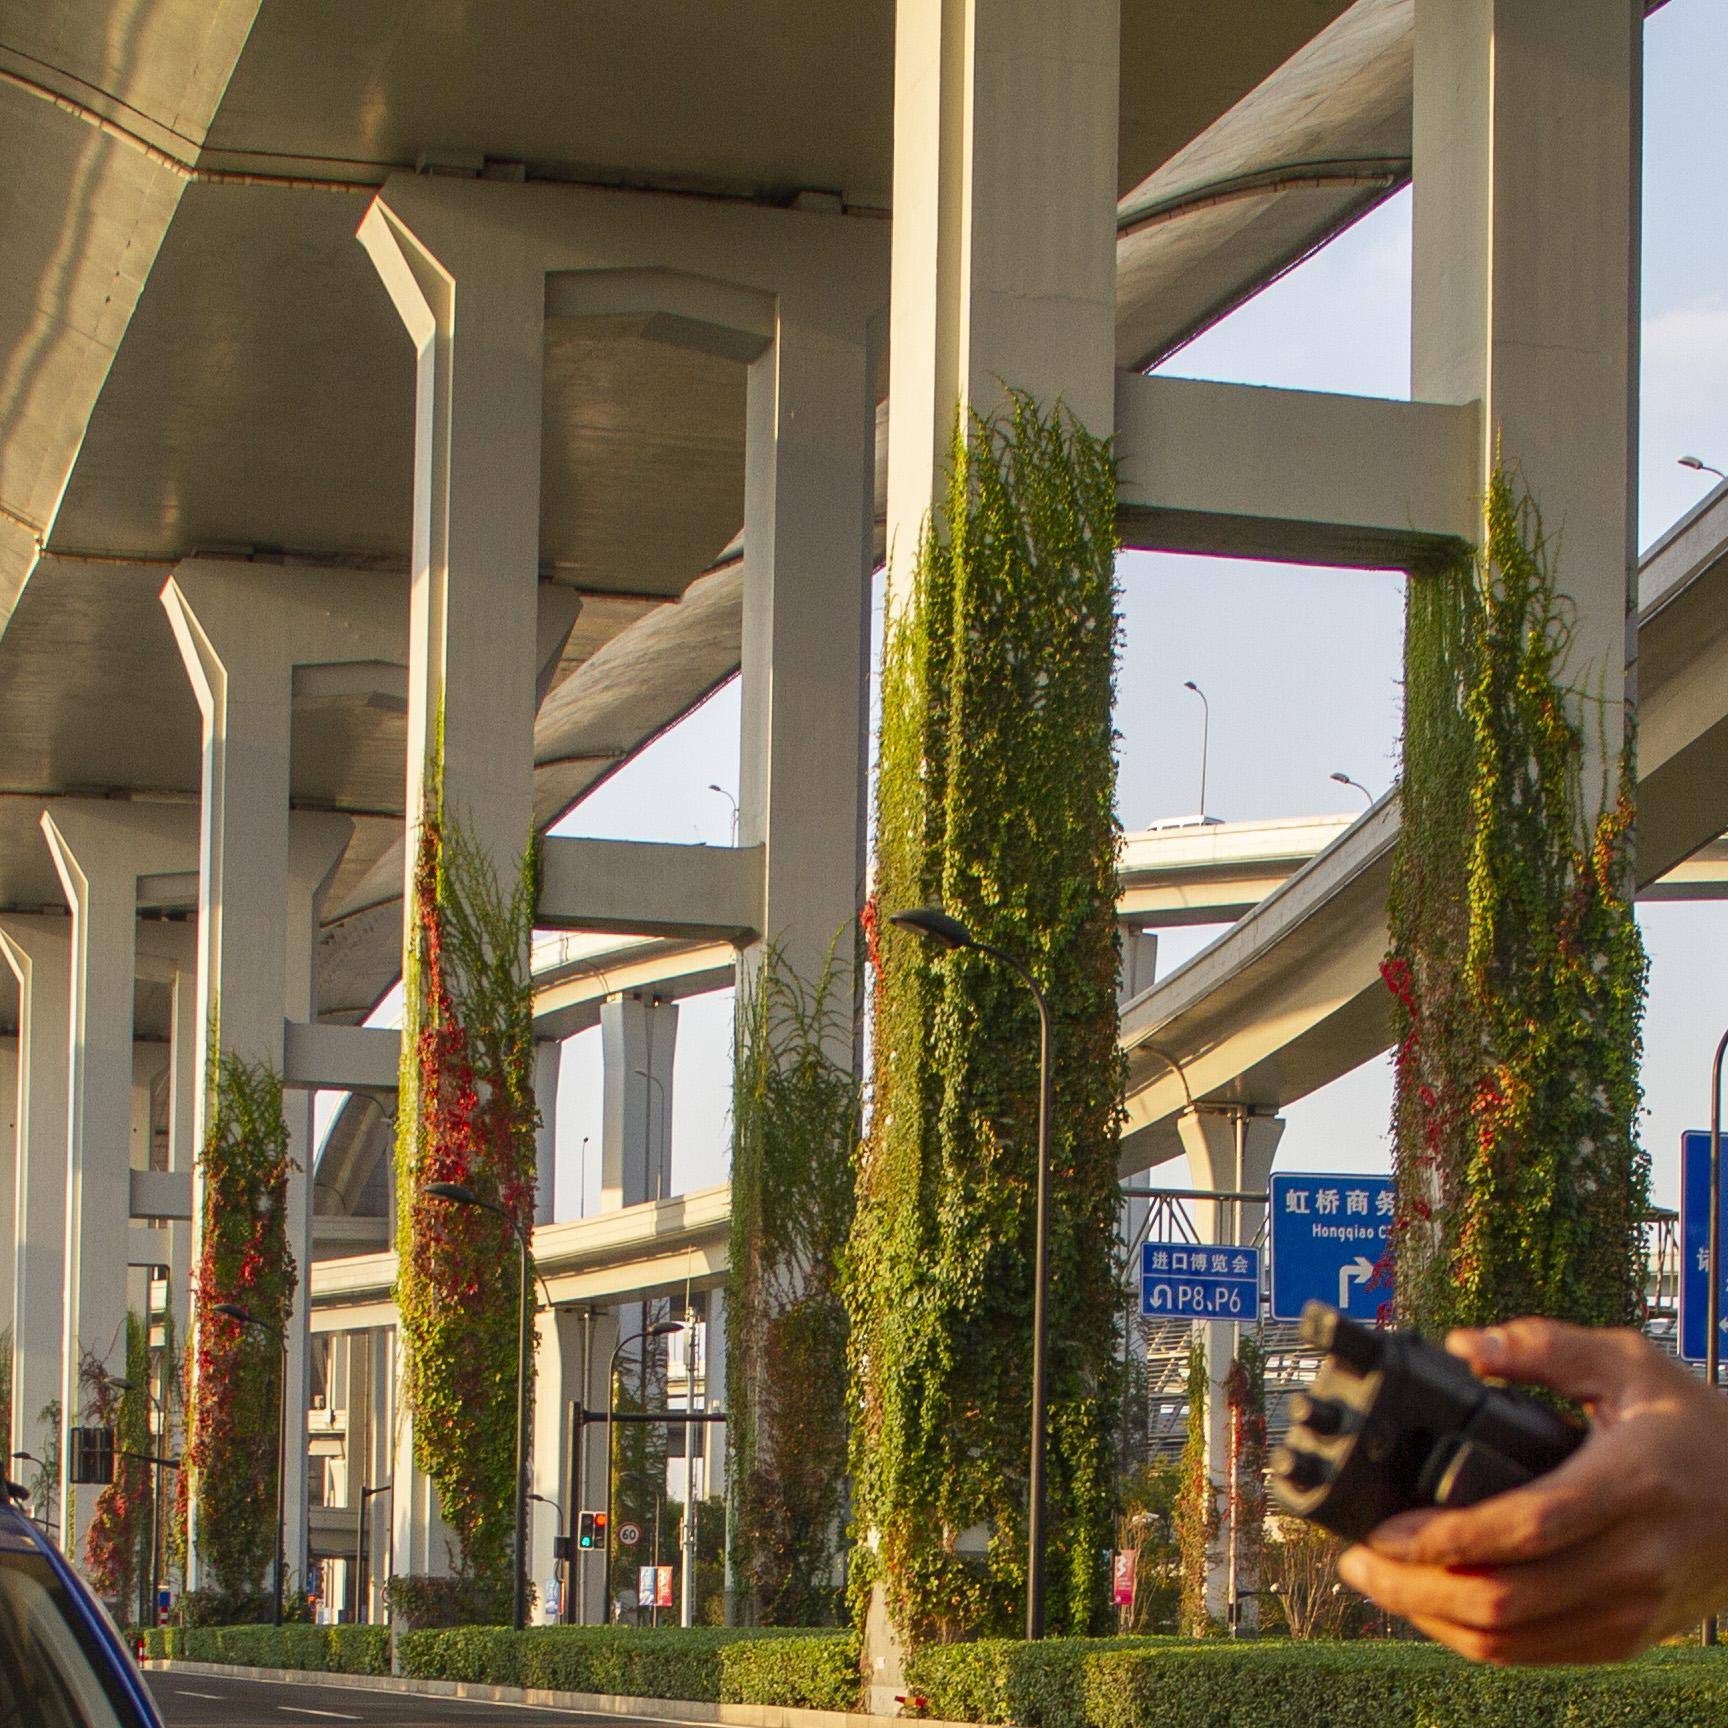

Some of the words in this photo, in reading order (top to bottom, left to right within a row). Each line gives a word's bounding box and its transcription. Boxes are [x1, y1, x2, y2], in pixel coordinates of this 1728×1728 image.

[1312, 1223, 1374, 1243] Hongqiao
[1151, 1251, 1249, 1274] 进口博览会
[622, 1528, 637, 1541] 60
